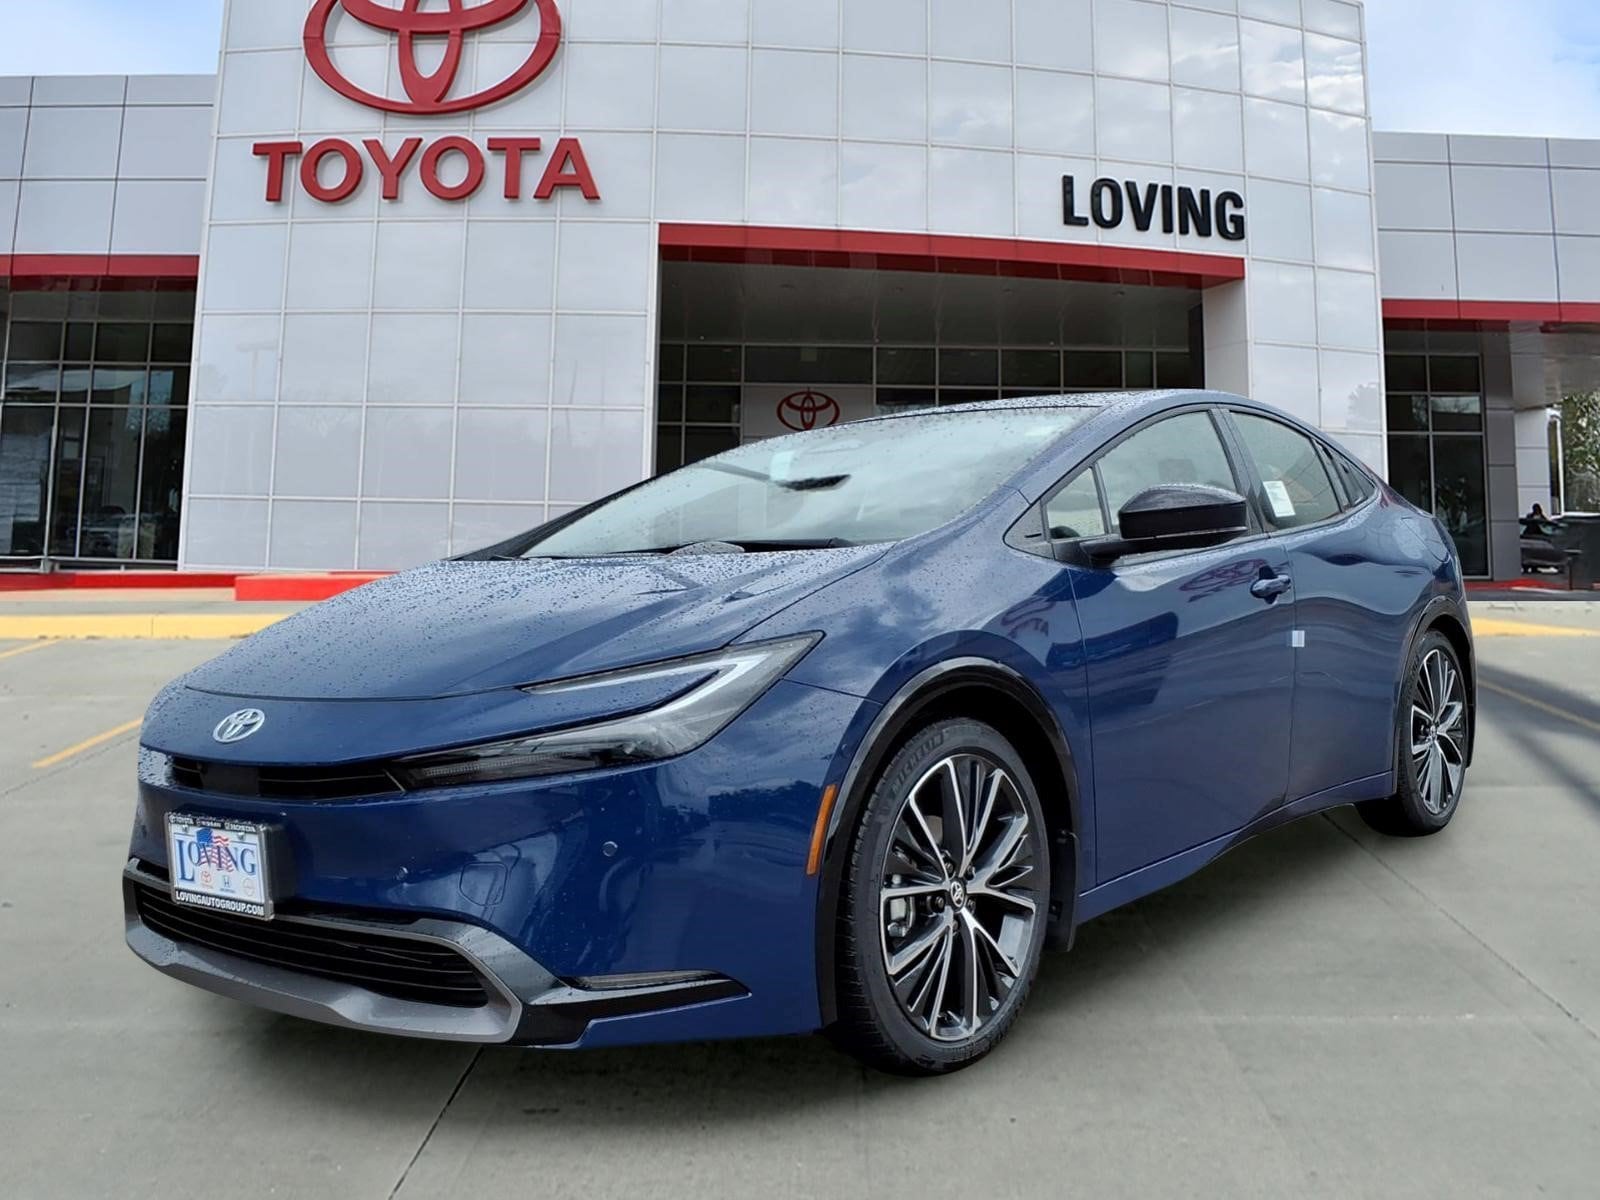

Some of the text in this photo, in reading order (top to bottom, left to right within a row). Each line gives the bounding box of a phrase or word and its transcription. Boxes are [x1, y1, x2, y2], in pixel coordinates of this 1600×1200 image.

[253, 136, 601, 203] TOYOTA
[1062, 174, 1246, 241] LOVING
[176, 839, 256, 882] LOVING
[175, 890, 265, 916] LOVINGAUTOGROUP.COM
